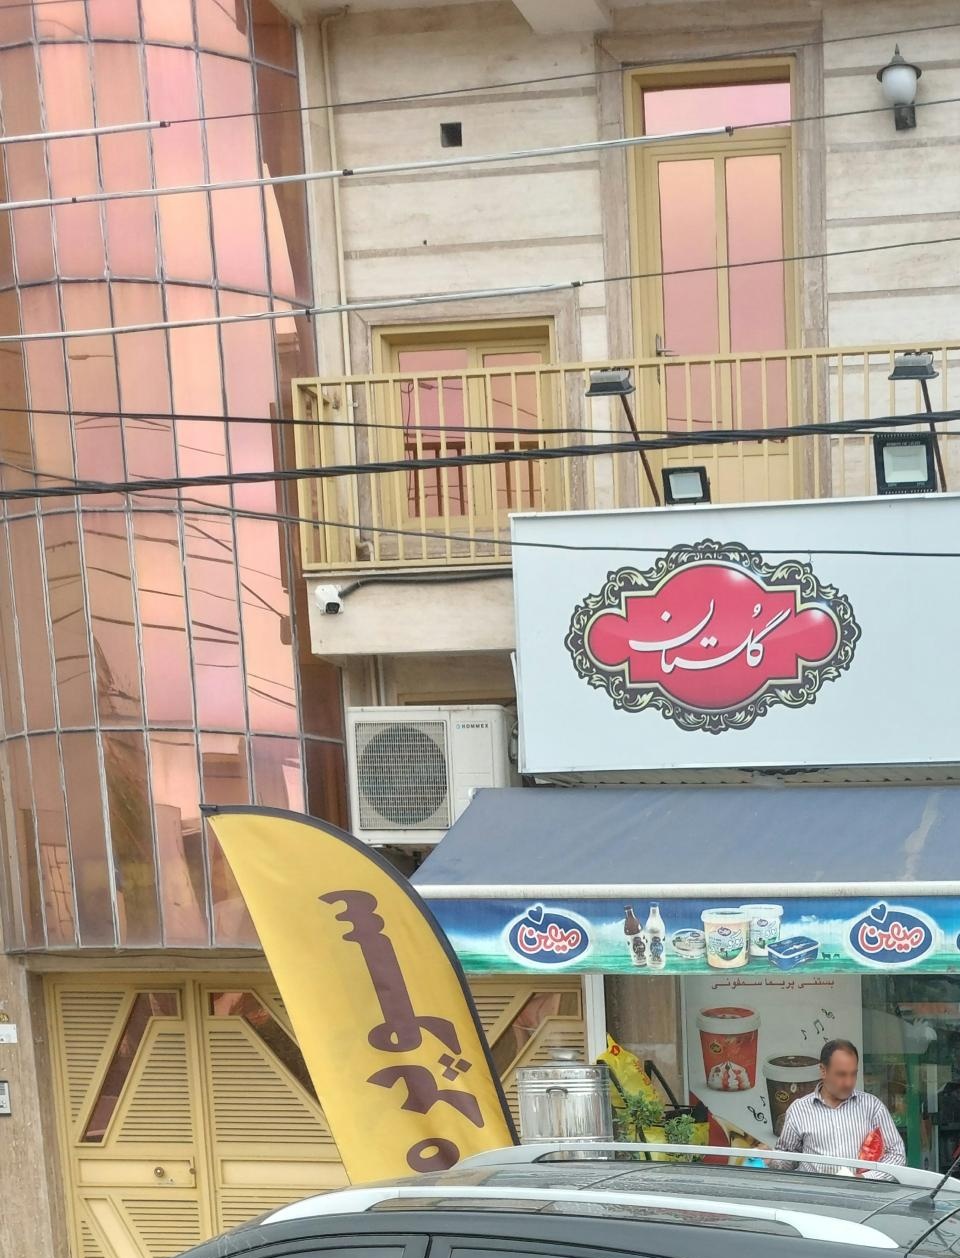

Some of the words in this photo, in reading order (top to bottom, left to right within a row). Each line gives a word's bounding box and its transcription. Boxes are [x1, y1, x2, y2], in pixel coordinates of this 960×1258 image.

[517, 923, 582, 955] میهن
[858, 921, 926, 954] میهن
[711, 977, 763, 991] سمفونی
[764, 977, 795, 991] پریما
[797, 976, 835, 990] بستنی
